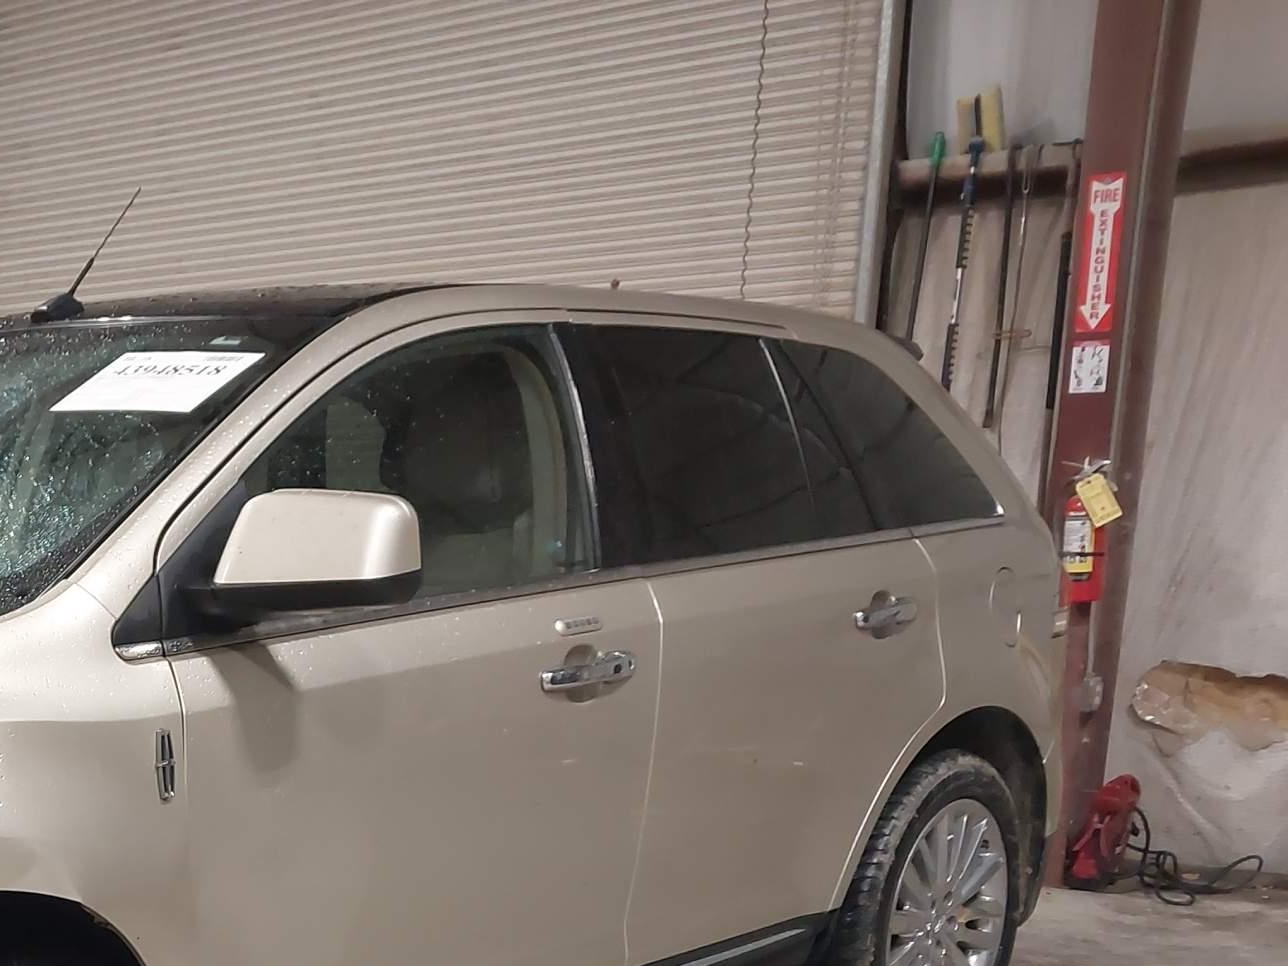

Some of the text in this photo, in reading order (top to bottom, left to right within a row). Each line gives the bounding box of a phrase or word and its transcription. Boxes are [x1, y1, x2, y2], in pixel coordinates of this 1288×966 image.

[1093, 188, 1121, 204] FIRE
[1089, 209, 1109, 320] EXTINGUISHER
[114, 364, 228, 376] 43948518
